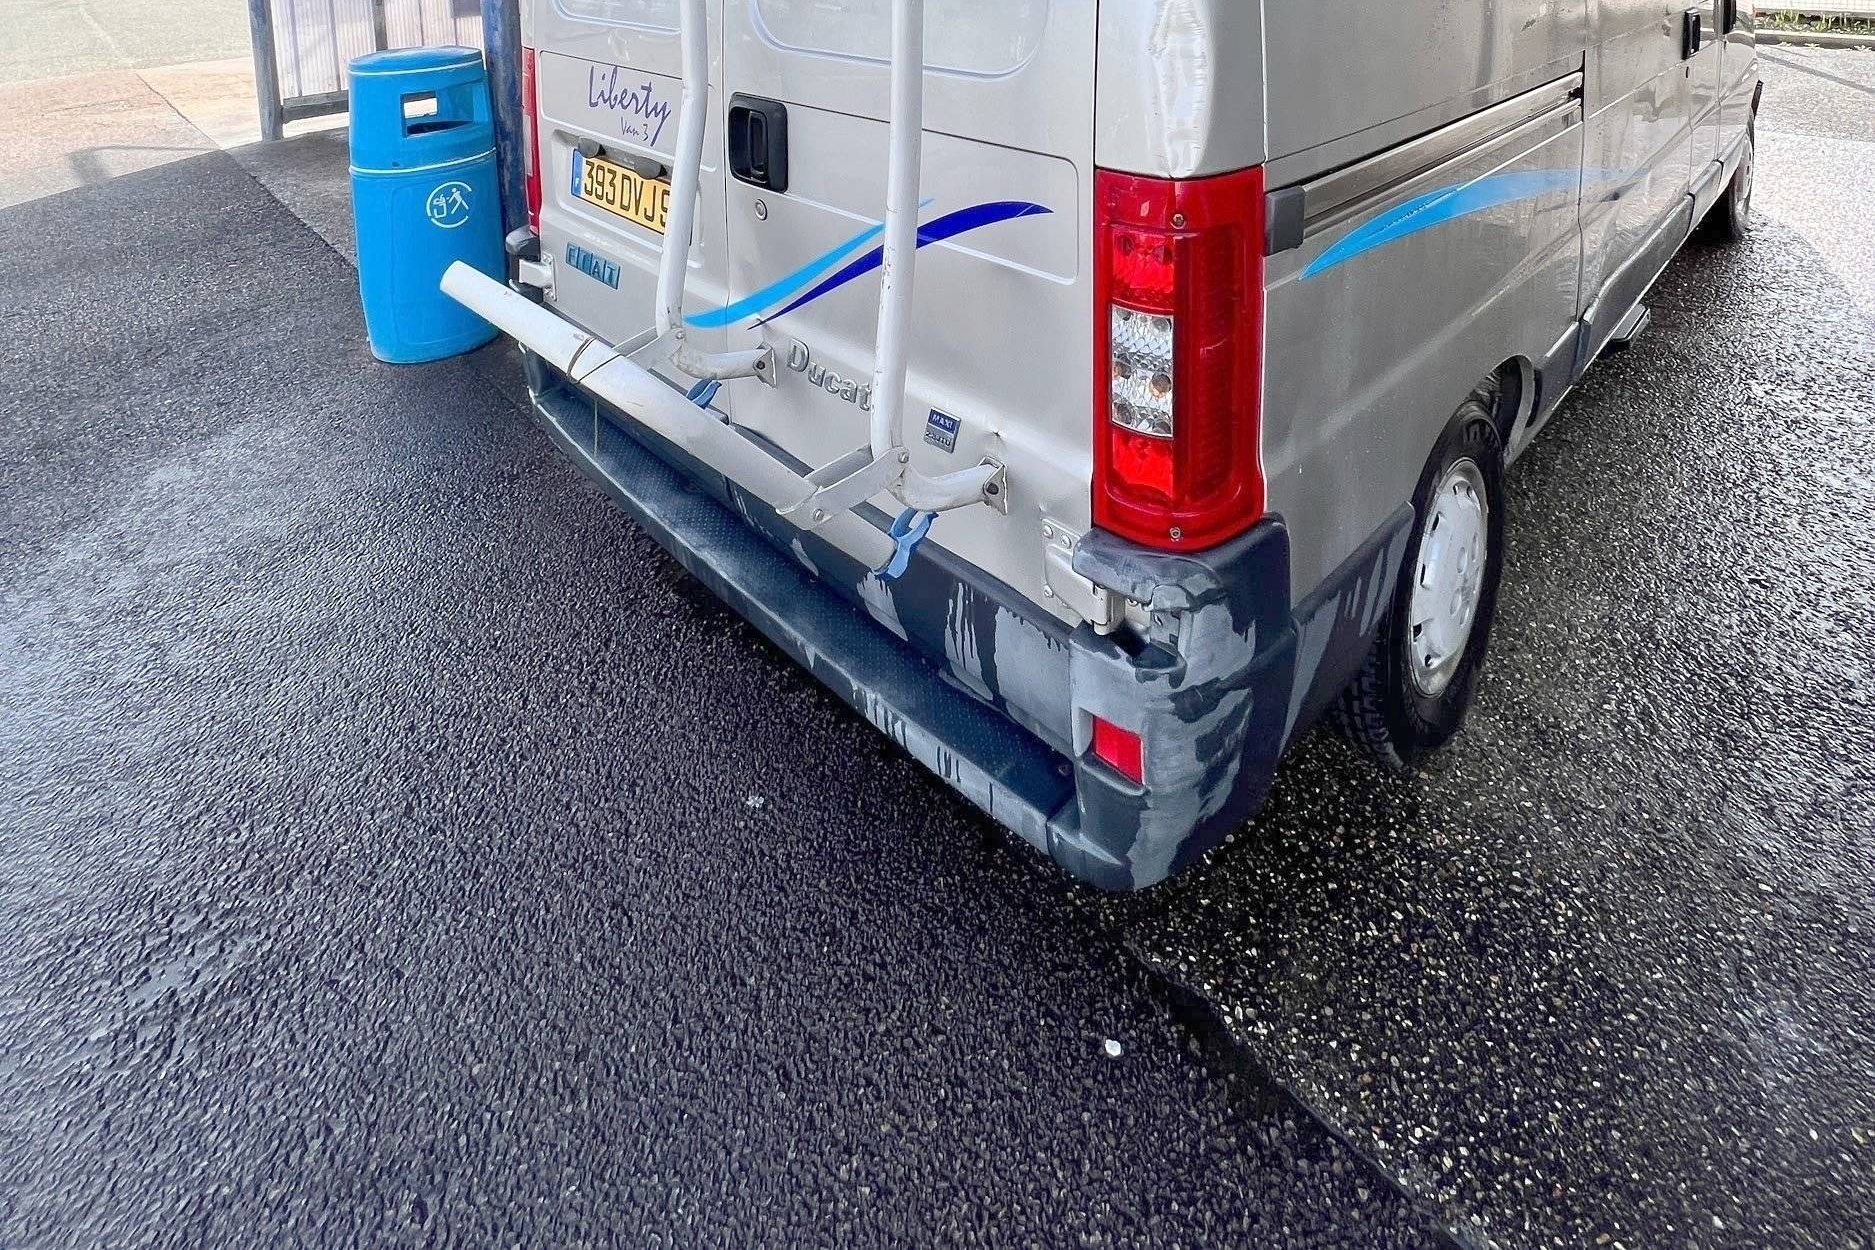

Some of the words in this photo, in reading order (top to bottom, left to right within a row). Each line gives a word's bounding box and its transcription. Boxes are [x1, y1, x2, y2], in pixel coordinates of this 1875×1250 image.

[589, 64, 672, 147] Liberty
[567, 245, 618, 287] FIAT
[787, 337, 873, 411] Ducat
